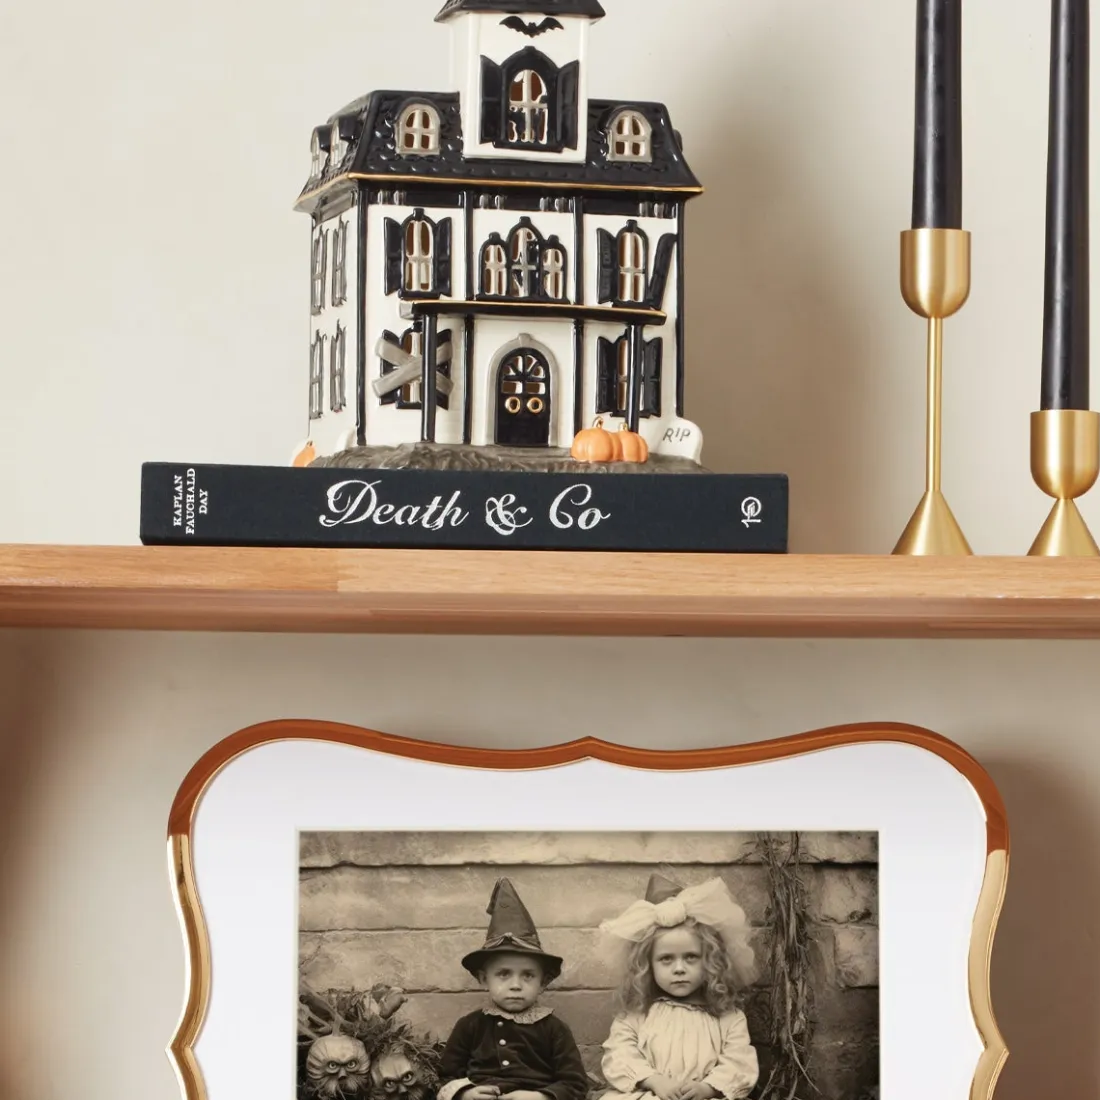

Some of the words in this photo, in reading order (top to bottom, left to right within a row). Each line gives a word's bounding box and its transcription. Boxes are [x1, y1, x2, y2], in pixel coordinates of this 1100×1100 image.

[662, 427, 691, 443] RIP
[173, 475, 183, 527] KAPLAN
[185, 468, 196, 535] FAUCHALD
[199, 488, 208, 515] DAY
[319, 480, 470, 531] Death
[485, 494, 534, 536] &
[549, 483, 612, 531] Co
